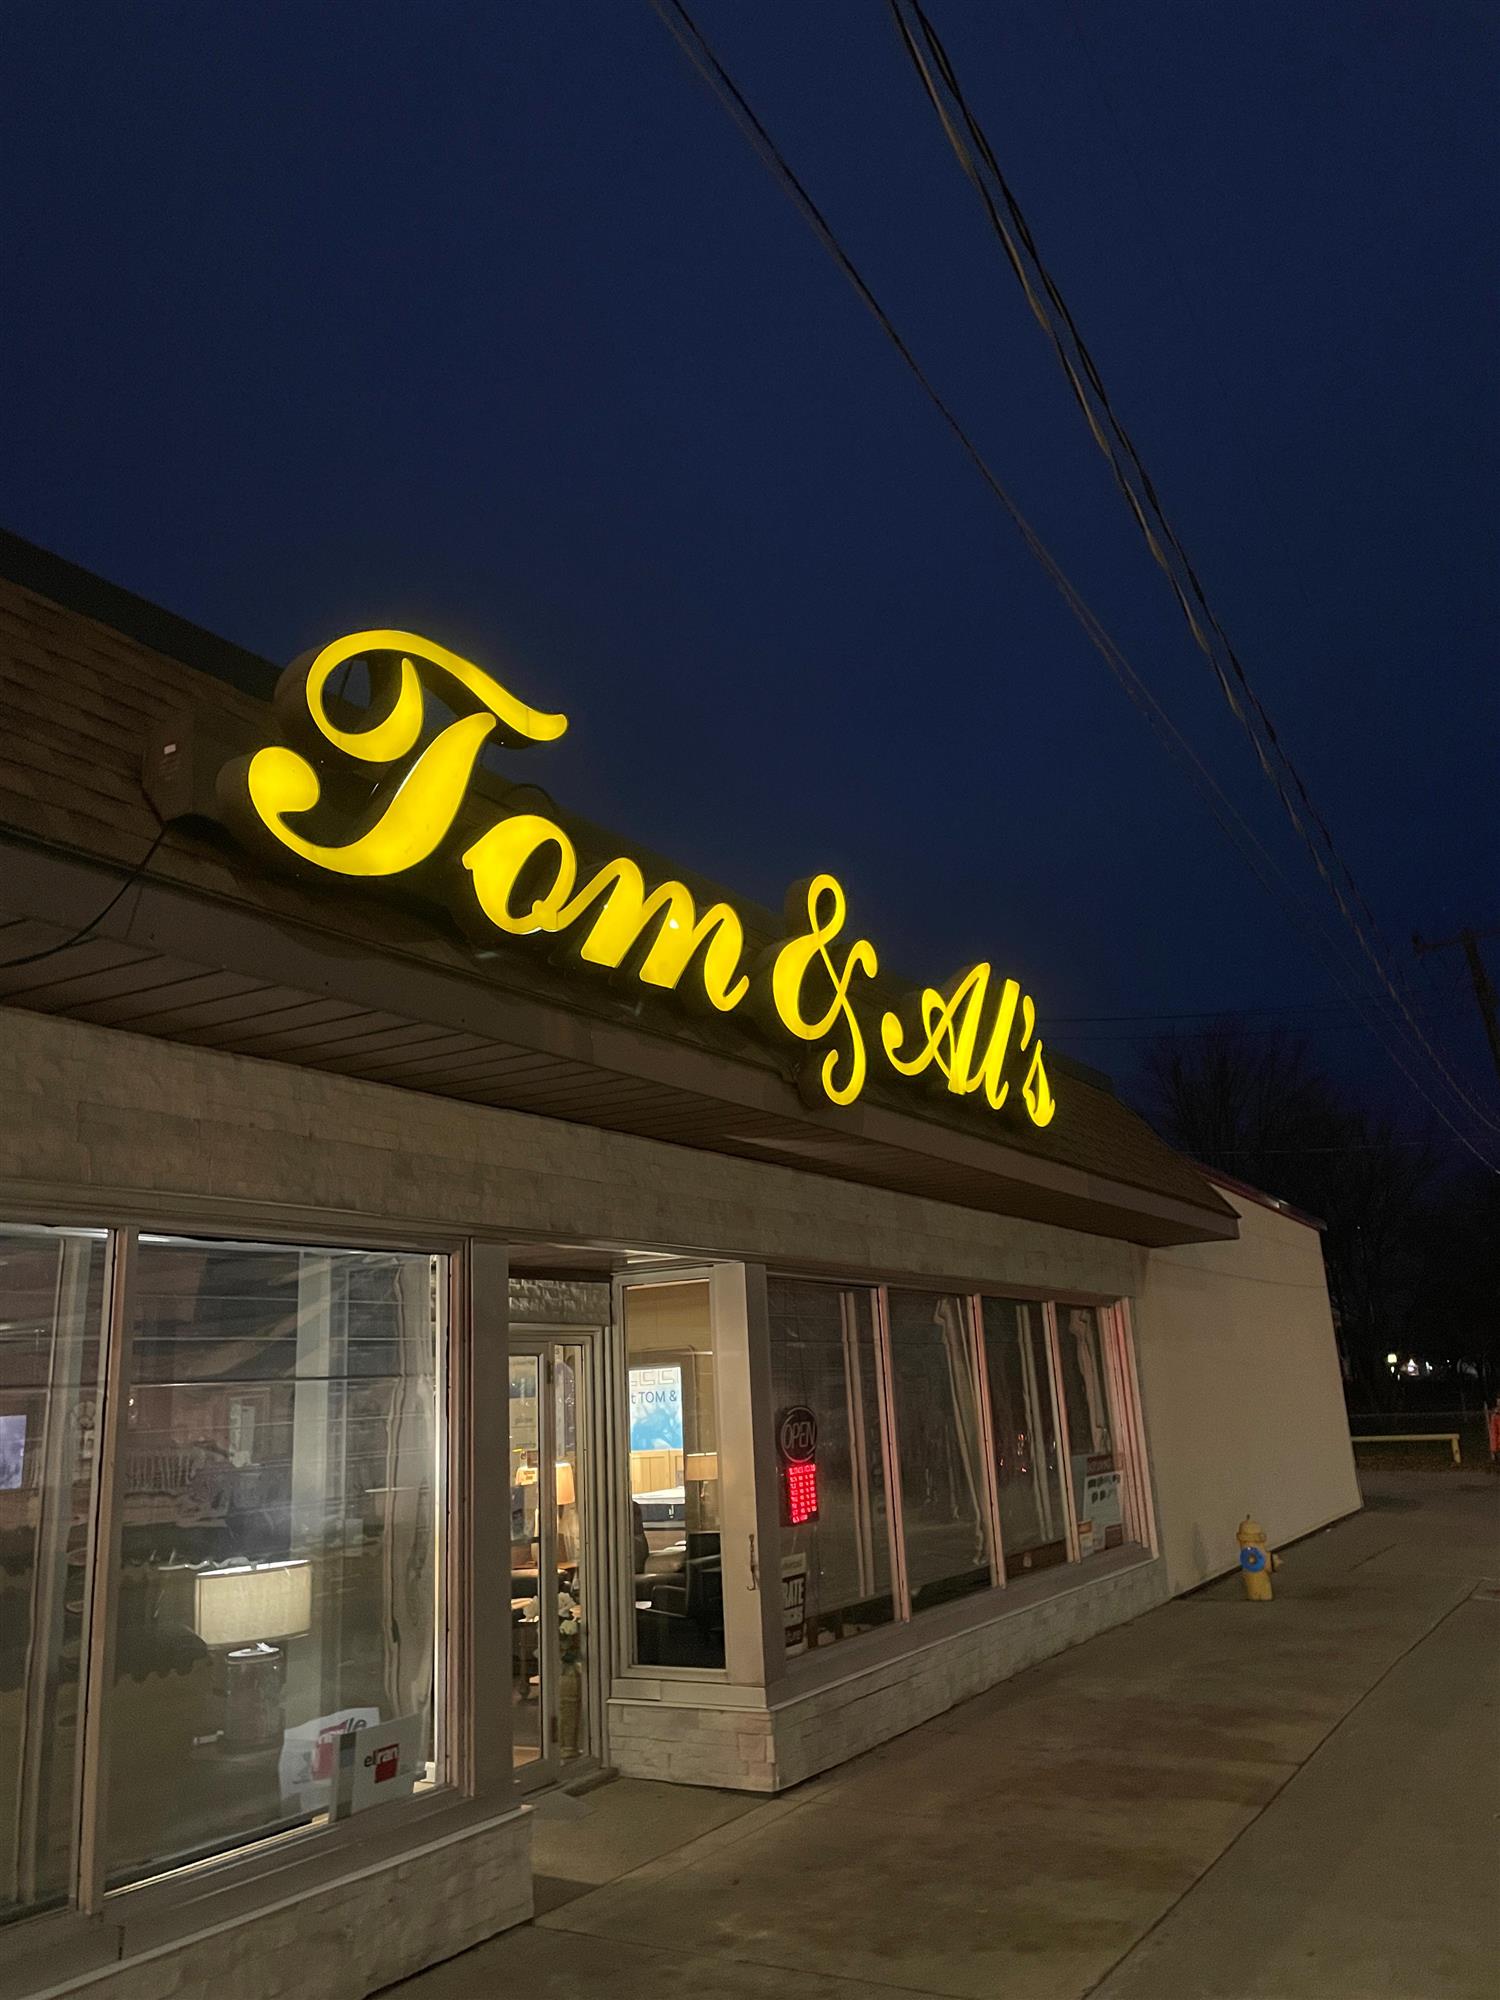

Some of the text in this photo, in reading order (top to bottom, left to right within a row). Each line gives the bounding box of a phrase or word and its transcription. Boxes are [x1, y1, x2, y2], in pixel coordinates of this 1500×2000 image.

[248, 629, 1056, 1128] Tom & Al's
[638, 1391, 666, 1404] TOM
[669, 1390, 677, 1402] &
[784, 1421, 816, 1449] OPEN
